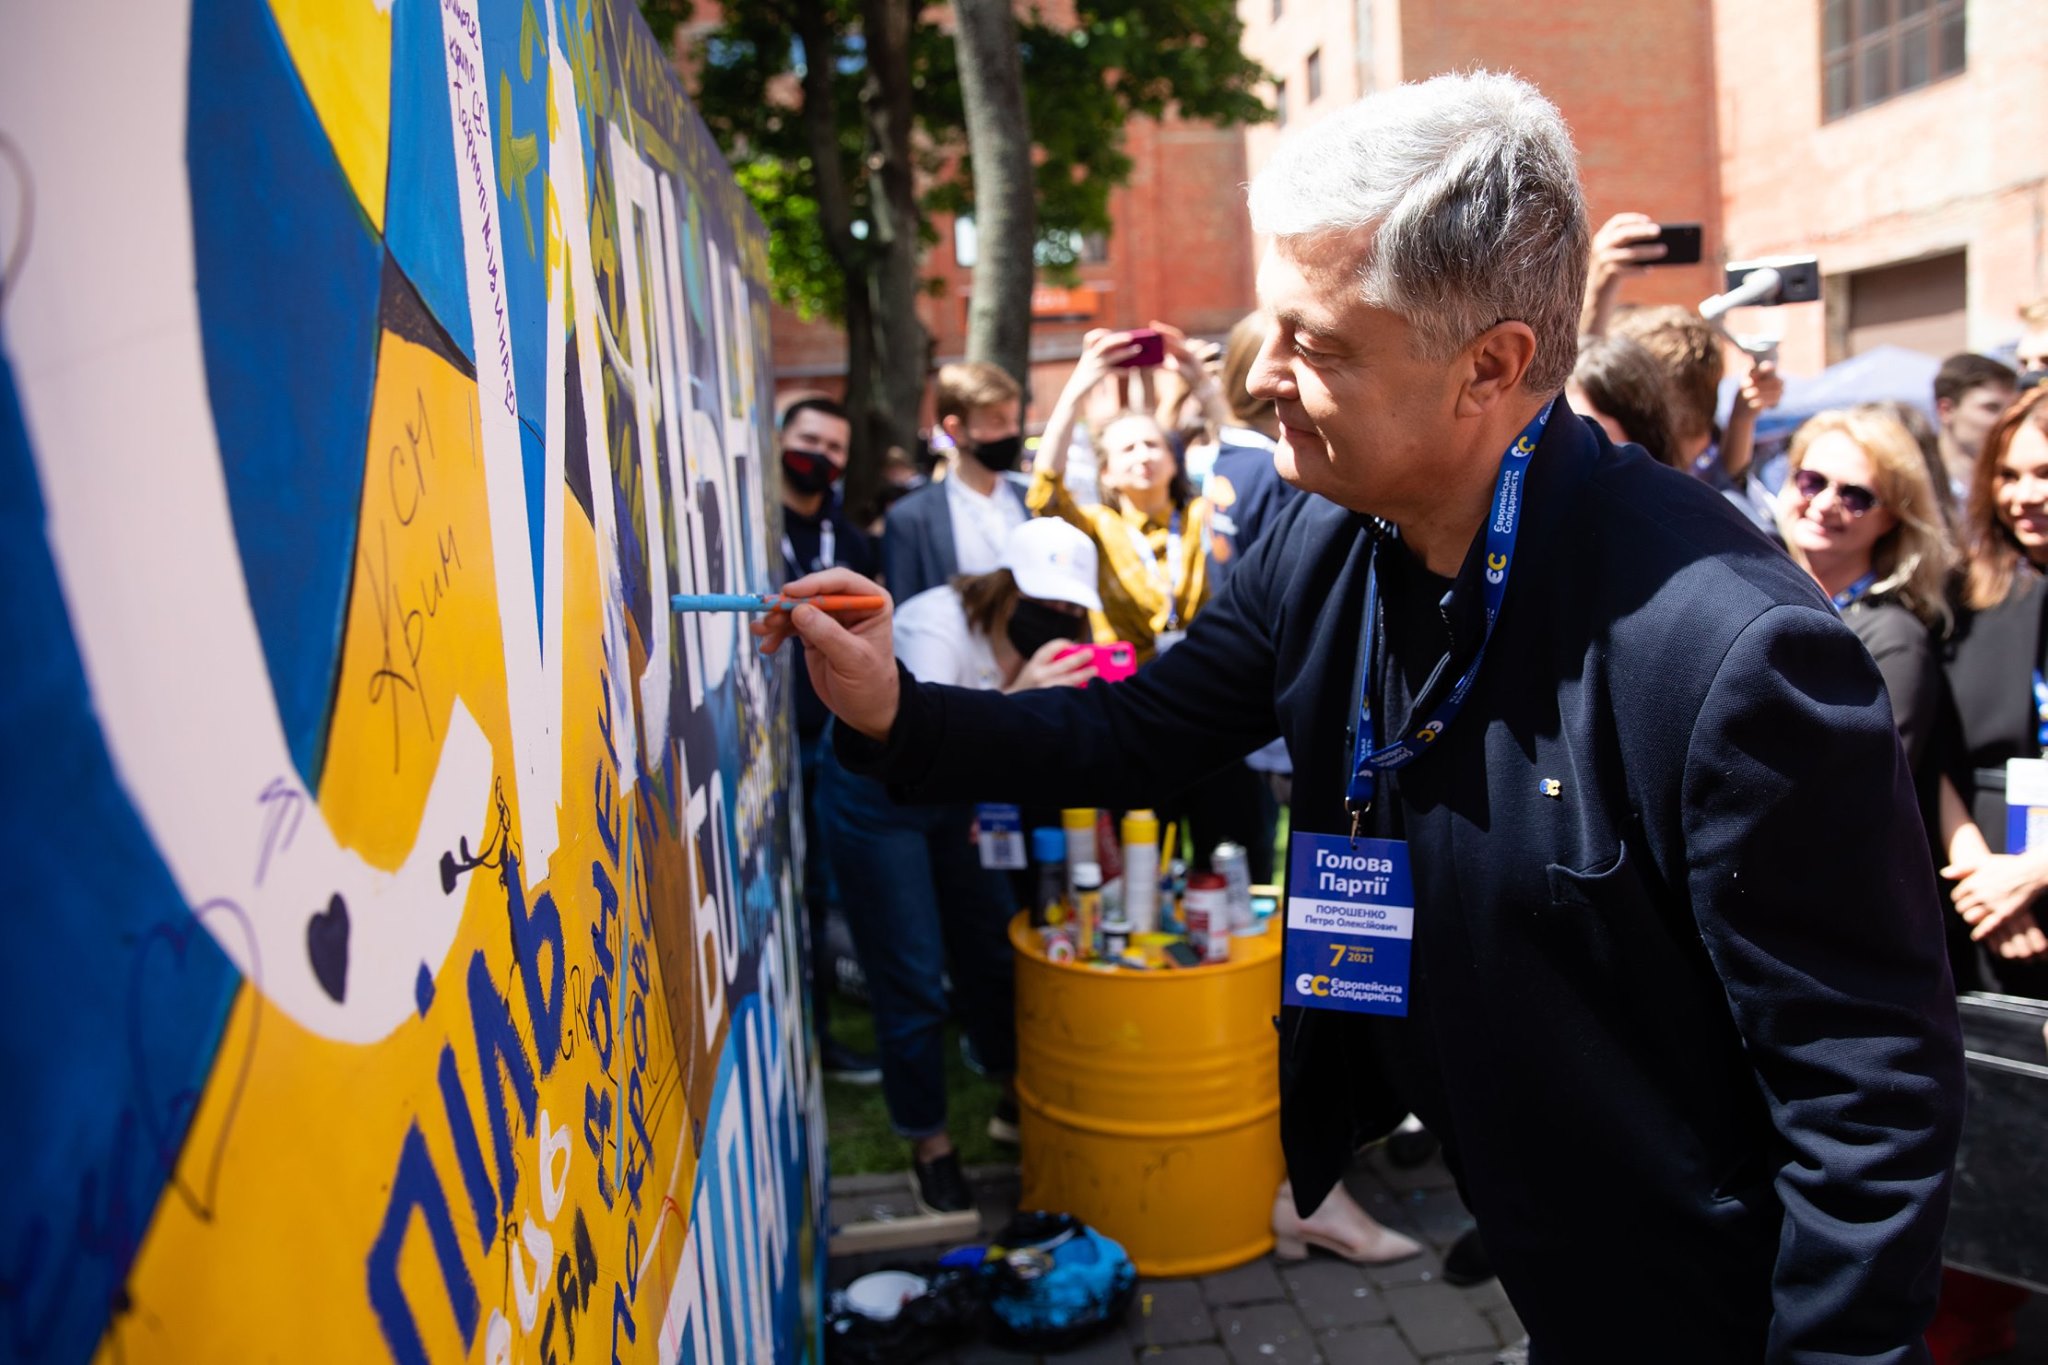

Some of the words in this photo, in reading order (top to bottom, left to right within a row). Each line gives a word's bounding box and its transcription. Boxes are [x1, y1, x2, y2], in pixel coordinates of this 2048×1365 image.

[1494, 470, 1512, 533] Європейська
[1502, 470, 1520, 534] Солідарність
[1316, 849, 1393, 873] Голова
[1319, 872, 1390, 897] Партії
[1305, 915, 1334, 927] Петро
[1336, 917, 1398, 932] Олексійович
[1316, 905, 1386, 920] ПОРОШЕНКО
[1329, 943, 1347, 967] 7
[1347, 951, 1374, 963] 2021
[1295, 973, 1330, 996] ЄС
[1330, 977, 1403, 994] Європейська
[1330, 987, 1402, 1003] Солідарність
